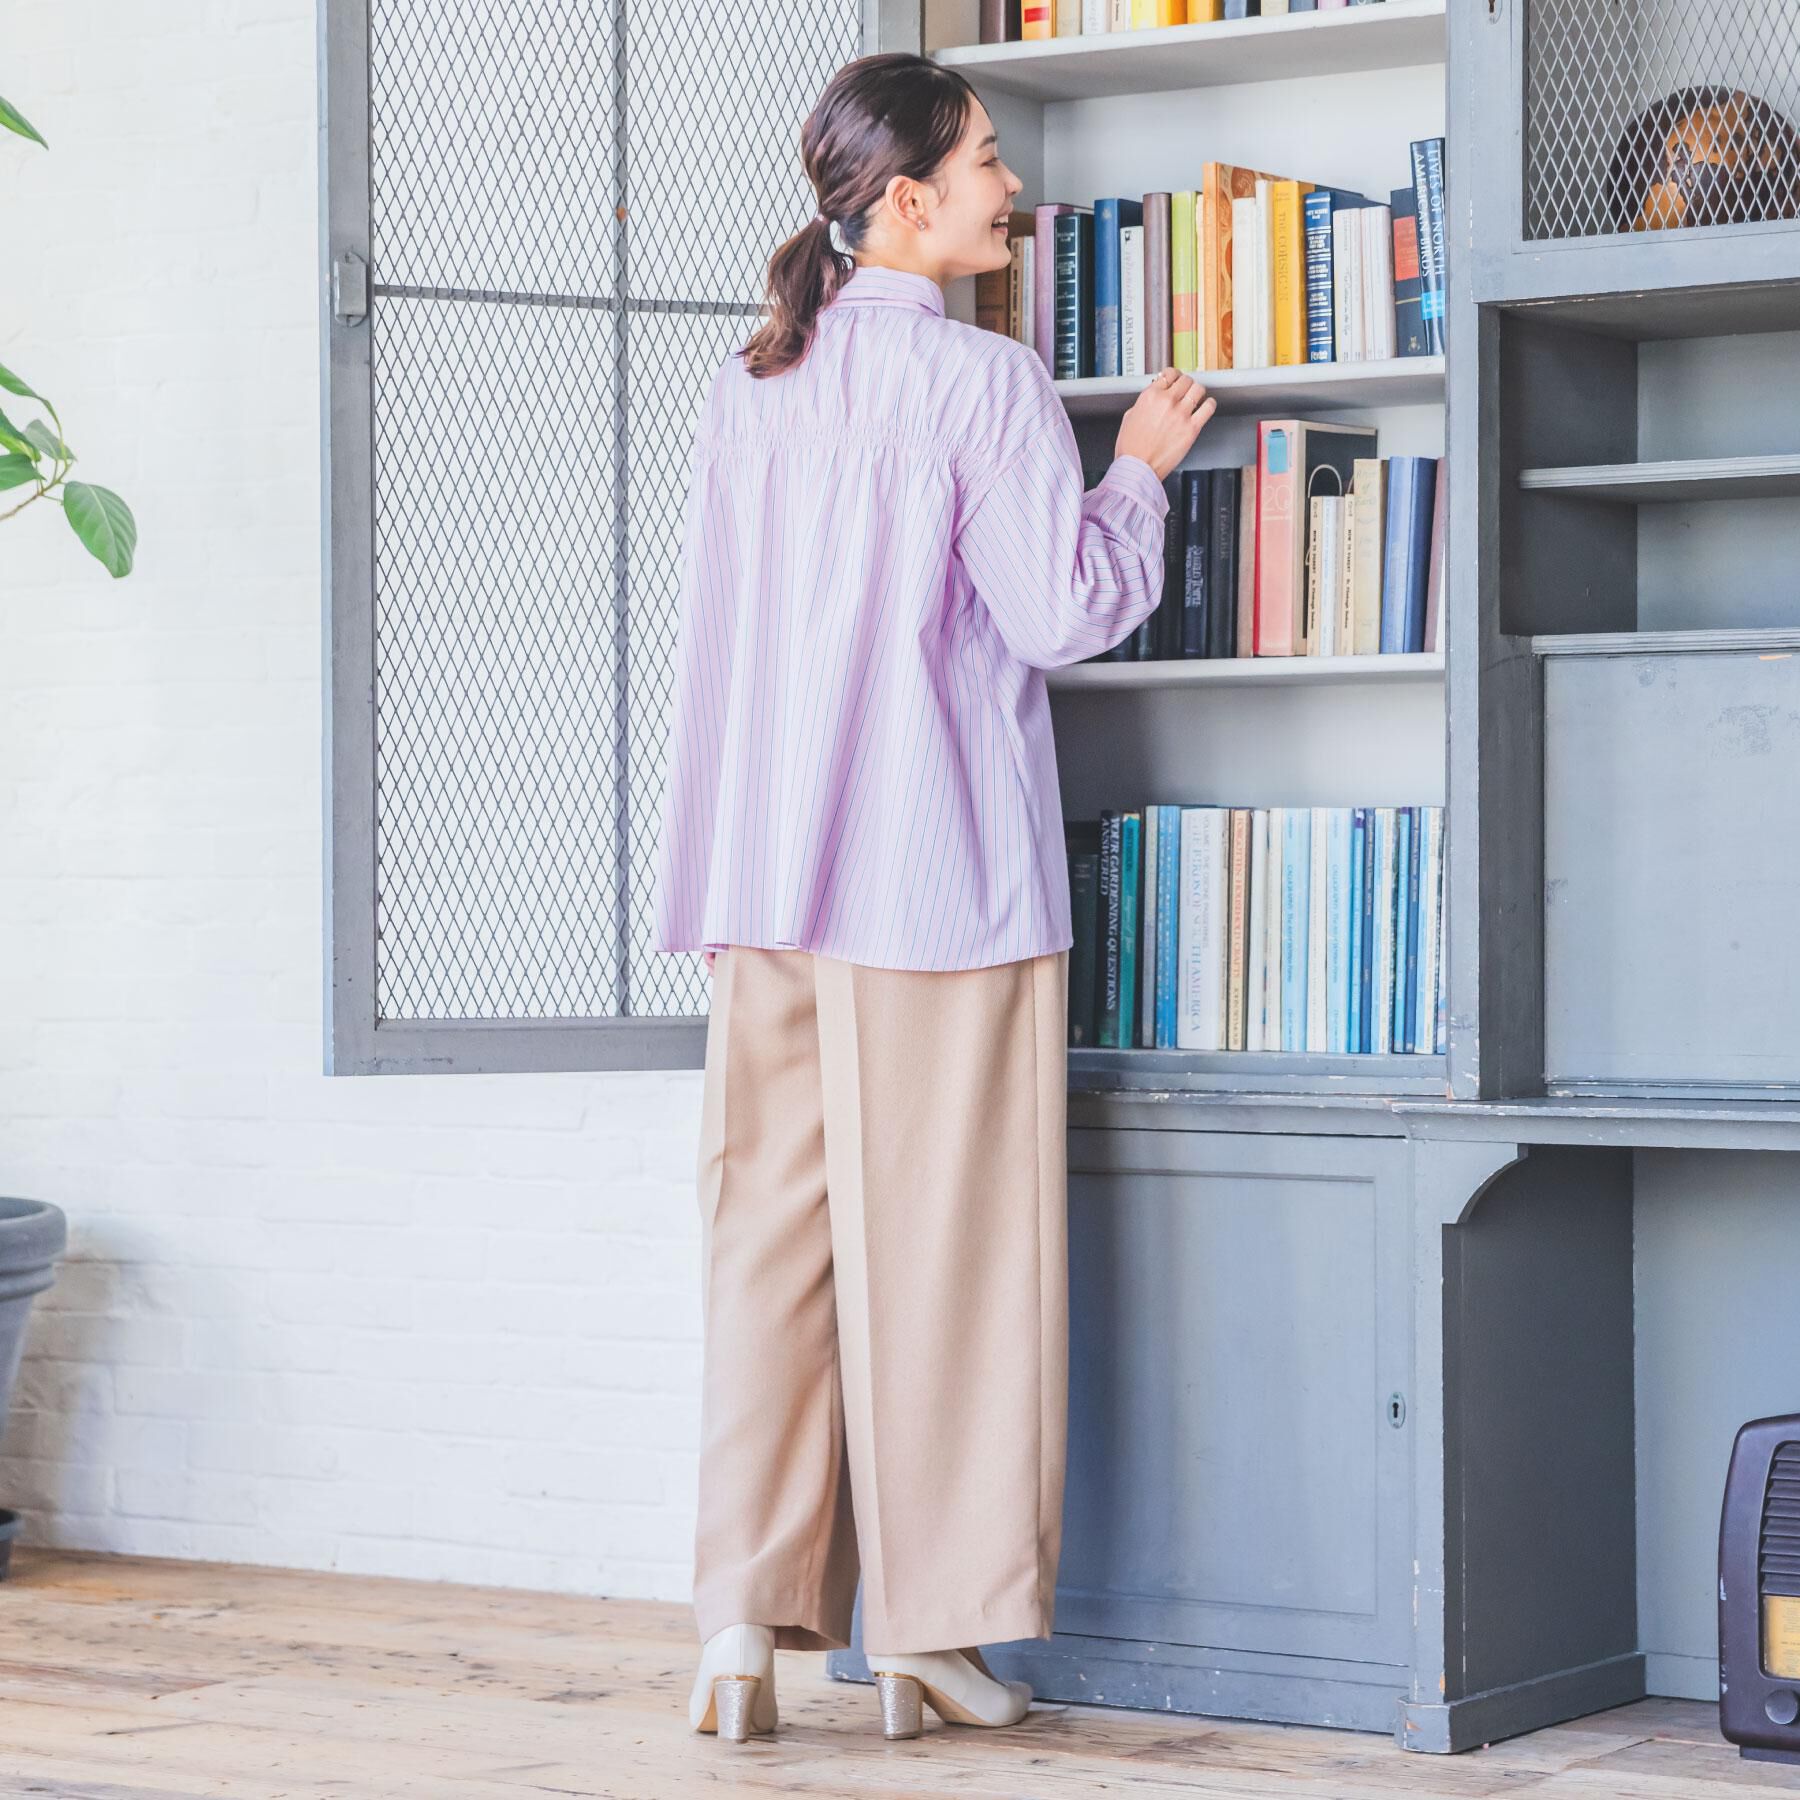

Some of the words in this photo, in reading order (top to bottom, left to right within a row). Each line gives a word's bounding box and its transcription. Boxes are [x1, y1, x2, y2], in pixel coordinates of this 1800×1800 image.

[1414, 151, 1429, 232] AMERICAN
[1428, 149, 1442, 189] LIVES
[1431, 195, 1443, 213] OF
[1278, 235, 1289, 302] CORSICAN
[1420, 238, 1432, 277] BIRDS
[1432, 221, 1445, 275] NORTH
[1125, 336, 1135, 376] TEPHEN
[1100, 818, 1109, 896] ANSWERED
[1110, 817, 1121, 853] YOUR
[1234, 817, 1244, 877] FORGOTTEN
[1108, 855, 1120, 936] GARDENING
[1191, 849, 1202, 890] BIRDS
[1191, 891, 1202, 909] OF
[1234, 880, 1243, 940] HOUSEHOLD
[1106, 937, 1118, 1010] QUESTIONS
[1233, 942, 1242, 978] CRAFTS
[1191, 968, 1201, 1032] AMERICA
